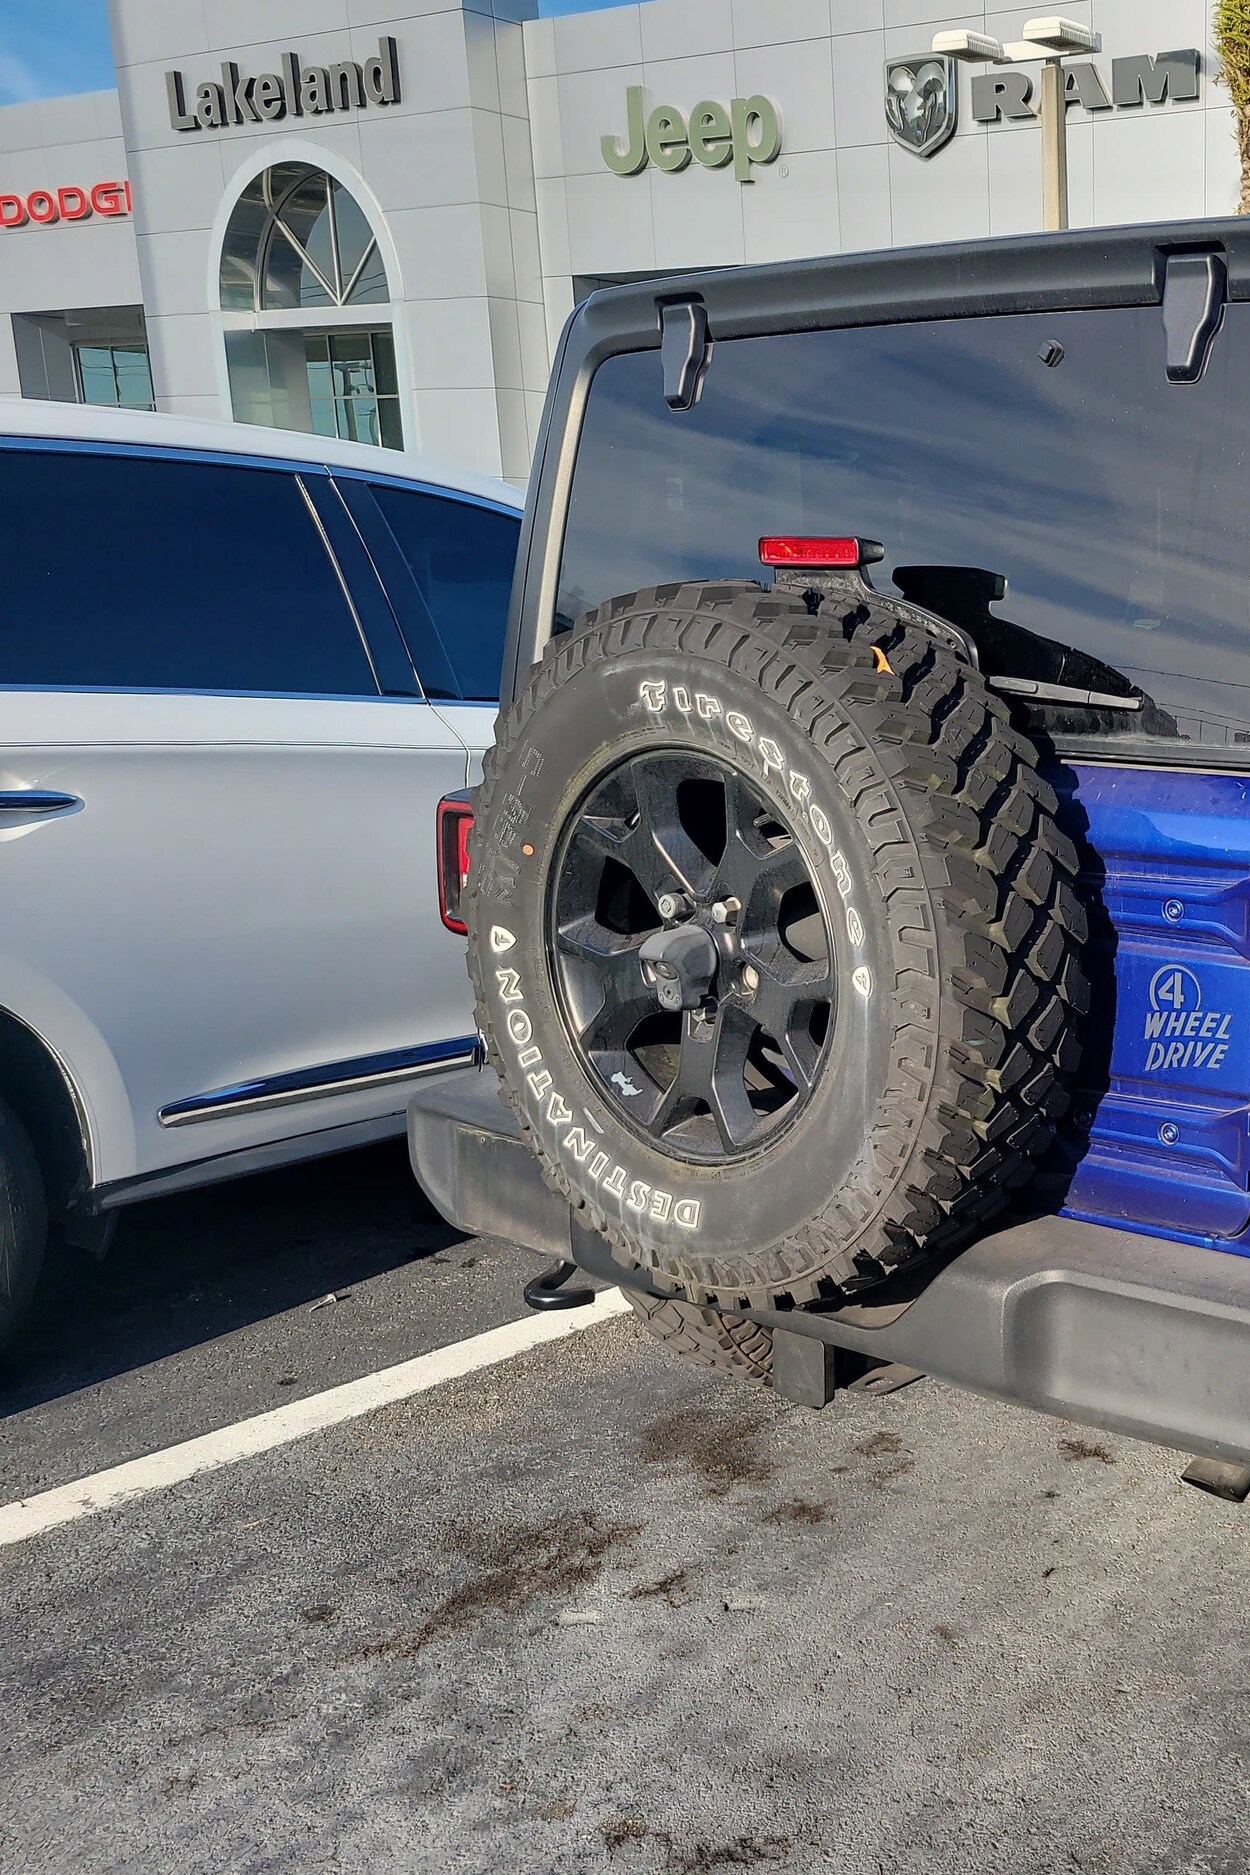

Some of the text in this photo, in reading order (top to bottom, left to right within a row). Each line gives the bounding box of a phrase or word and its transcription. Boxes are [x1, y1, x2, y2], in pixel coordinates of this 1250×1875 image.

[164, 35, 401, 131] Lakeland
[970, 48, 1200, 123] RAM
[600, 84, 783, 183] Jeep
[639, 679, 866, 948] Firestone
[1143, 1011, 1232, 1040] WHEEL
[1157, 971, 1185, 1010] 4
[495, 966, 702, 1230] DESTINATION
[1144, 1041, 1229, 1072] DRIVE
